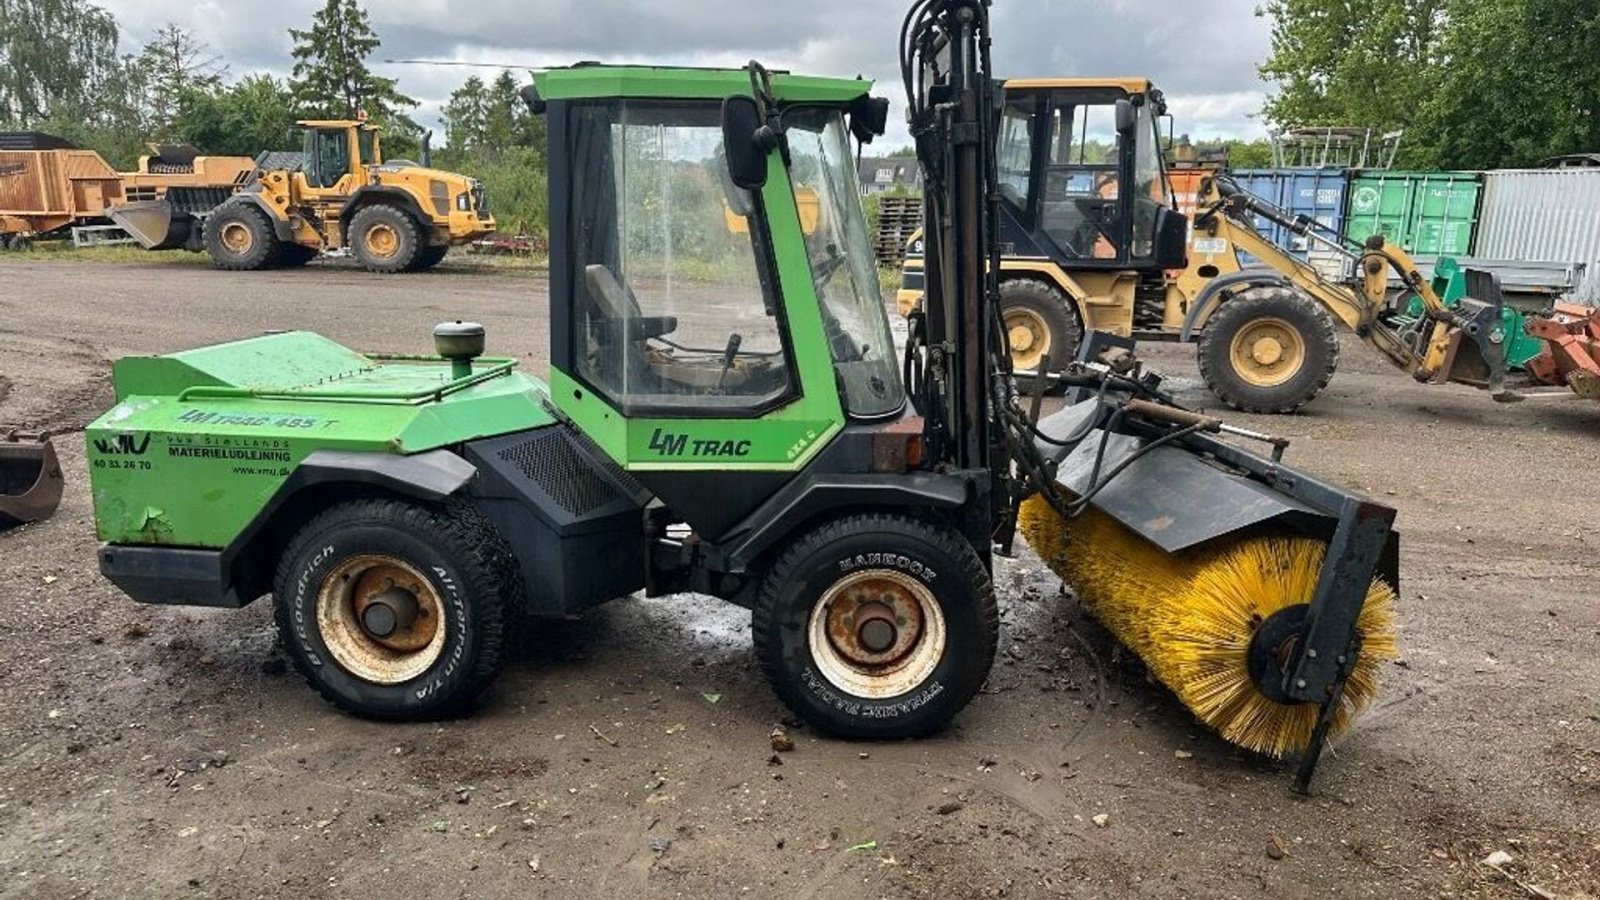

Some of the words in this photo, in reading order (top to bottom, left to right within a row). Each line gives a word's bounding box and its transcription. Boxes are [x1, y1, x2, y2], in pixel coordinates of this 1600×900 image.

[214, 414, 270, 427] TRAC
[648, 428, 688, 456] LM
[692, 440, 752, 456] TRAC
[168, 447, 291, 462] MATERIELUDLEJNING
[138, 460, 152, 470] 70
[838, 552, 937, 582] HANKOOK
